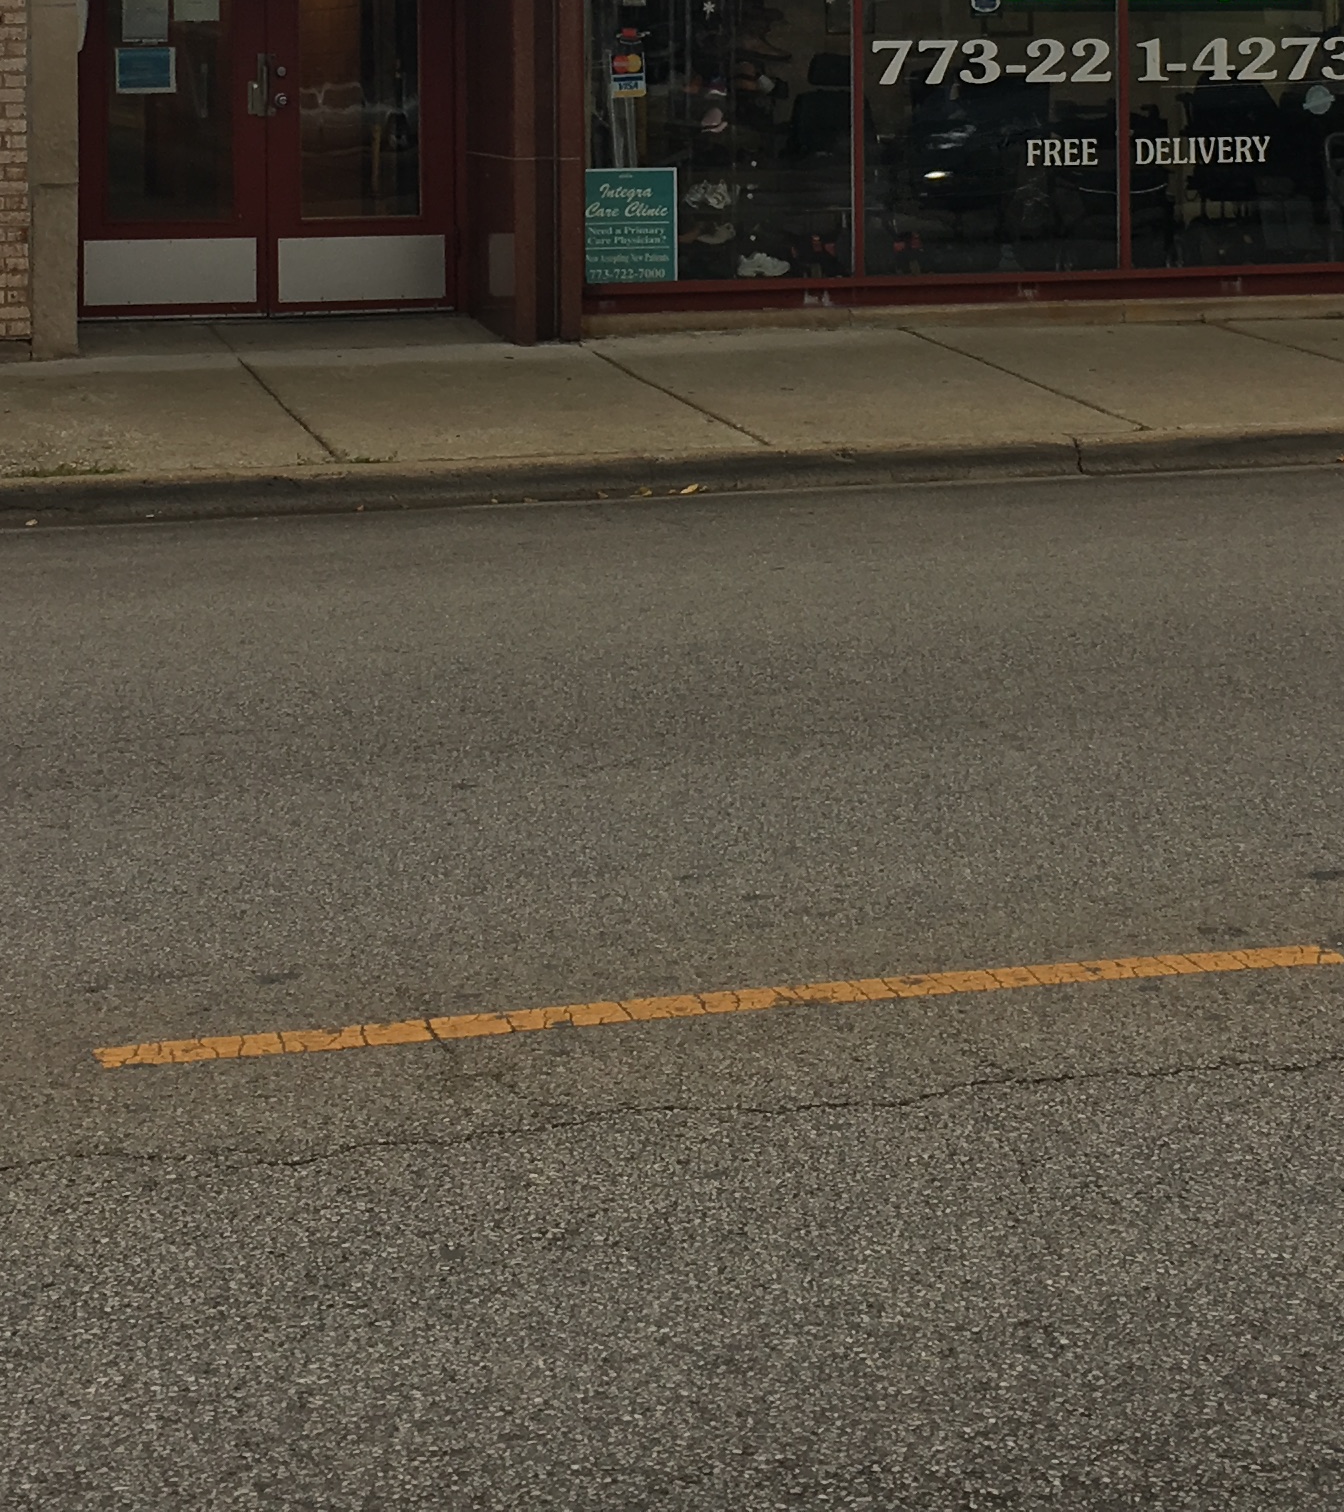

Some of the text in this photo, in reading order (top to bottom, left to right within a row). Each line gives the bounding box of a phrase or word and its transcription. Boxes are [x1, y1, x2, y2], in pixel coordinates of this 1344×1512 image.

[1026, 135, 1271, 166] FREE DELIVERY
[600, 183, 654, 202] Integra
[585, 201, 669, 218] Care Clinic
[623, 226, 665, 237] Primary
[587, 235, 666, 246] Care Physician?
[589, 268, 666, 280] 773-722-7000
